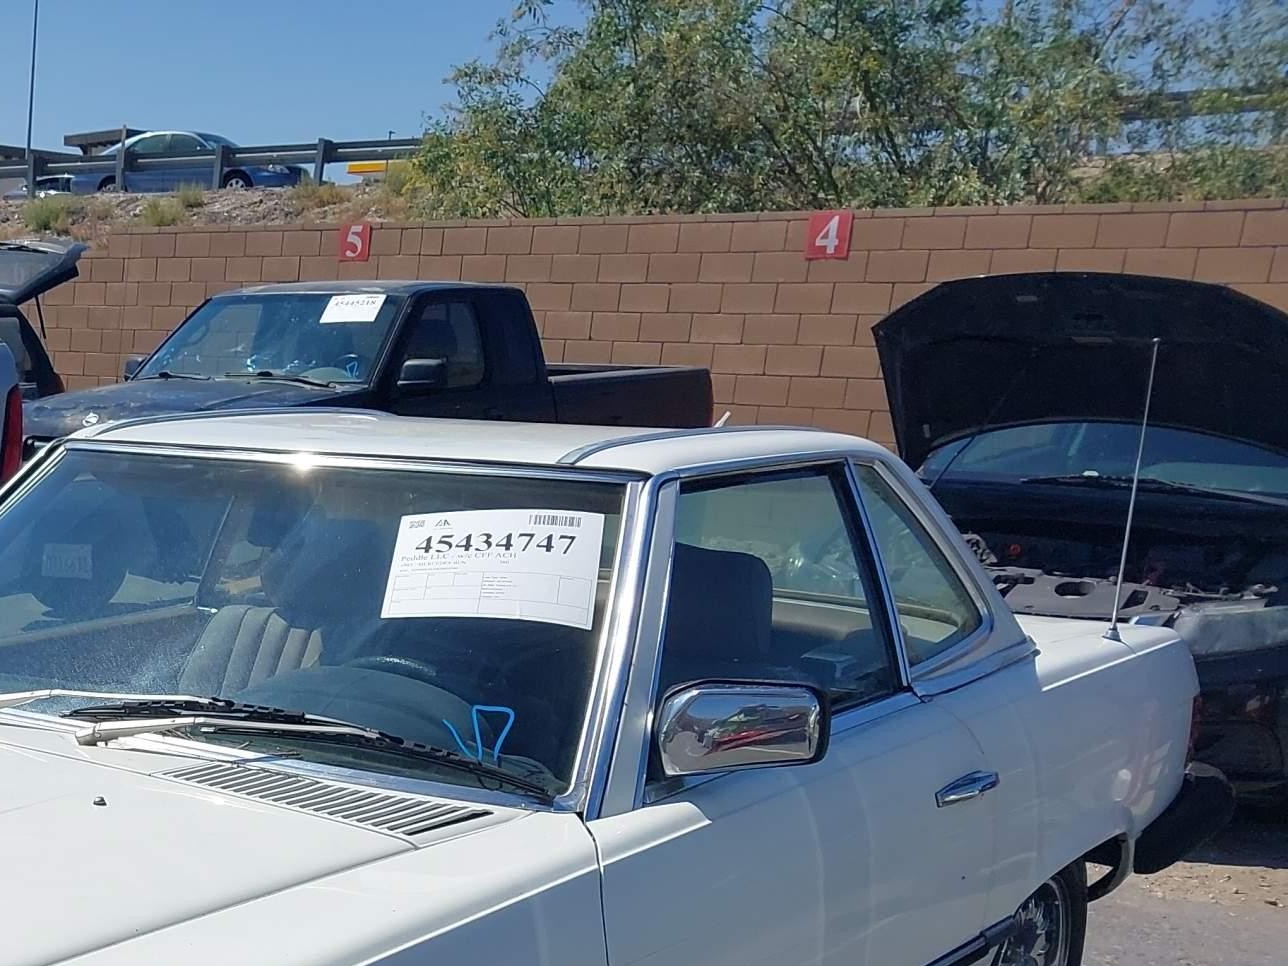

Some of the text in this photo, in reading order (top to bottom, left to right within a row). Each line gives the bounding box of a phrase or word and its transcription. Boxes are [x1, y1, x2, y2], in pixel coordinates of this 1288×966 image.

[344, 225, 364, 257] 5
[814, 215, 840, 254] 4
[415, 532, 577, 554] 45434747
